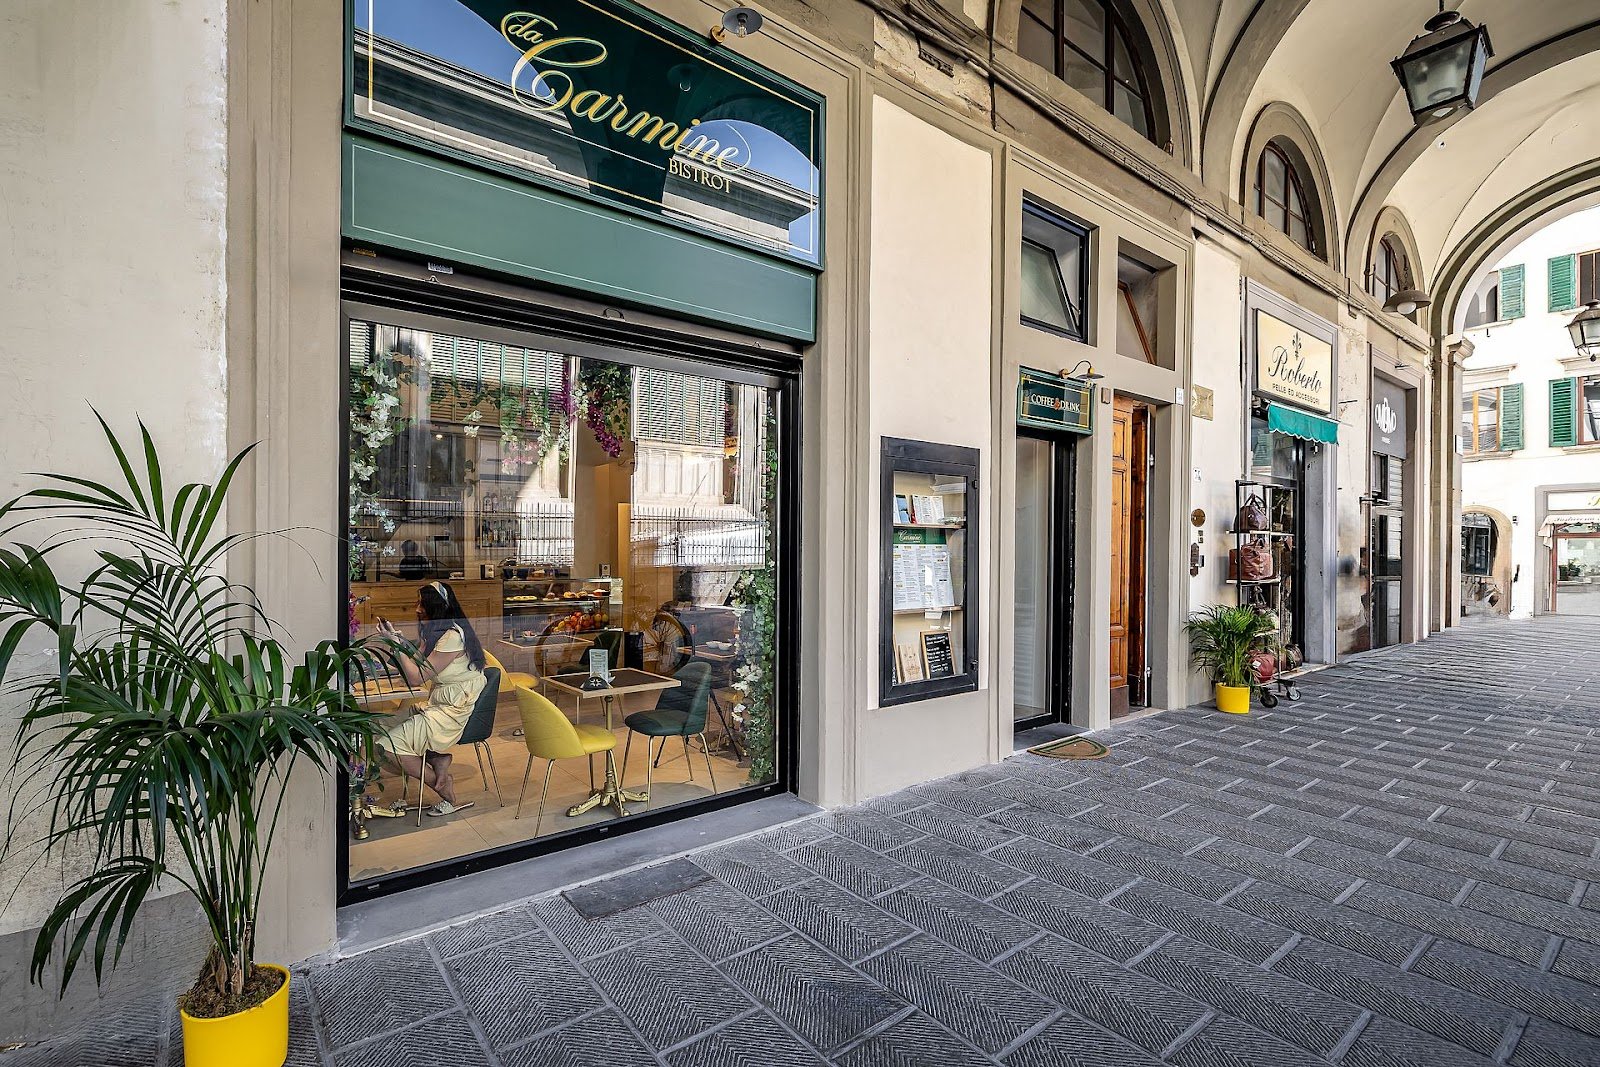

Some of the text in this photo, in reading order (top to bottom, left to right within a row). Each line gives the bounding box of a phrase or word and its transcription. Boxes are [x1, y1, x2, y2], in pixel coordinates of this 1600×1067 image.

[508, 18, 544, 44] da
[501, 12, 751, 172] Carmine
[668, 158, 733, 194] BISTROT
[1268, 345, 1322, 393] Roberto
[1031, 394, 1054, 407] COFFEE
[1060, 401, 1080, 413] DRINK
[1272, 383, 1287, 394] PELLE
[1288, 388, 1295, 397] ED
